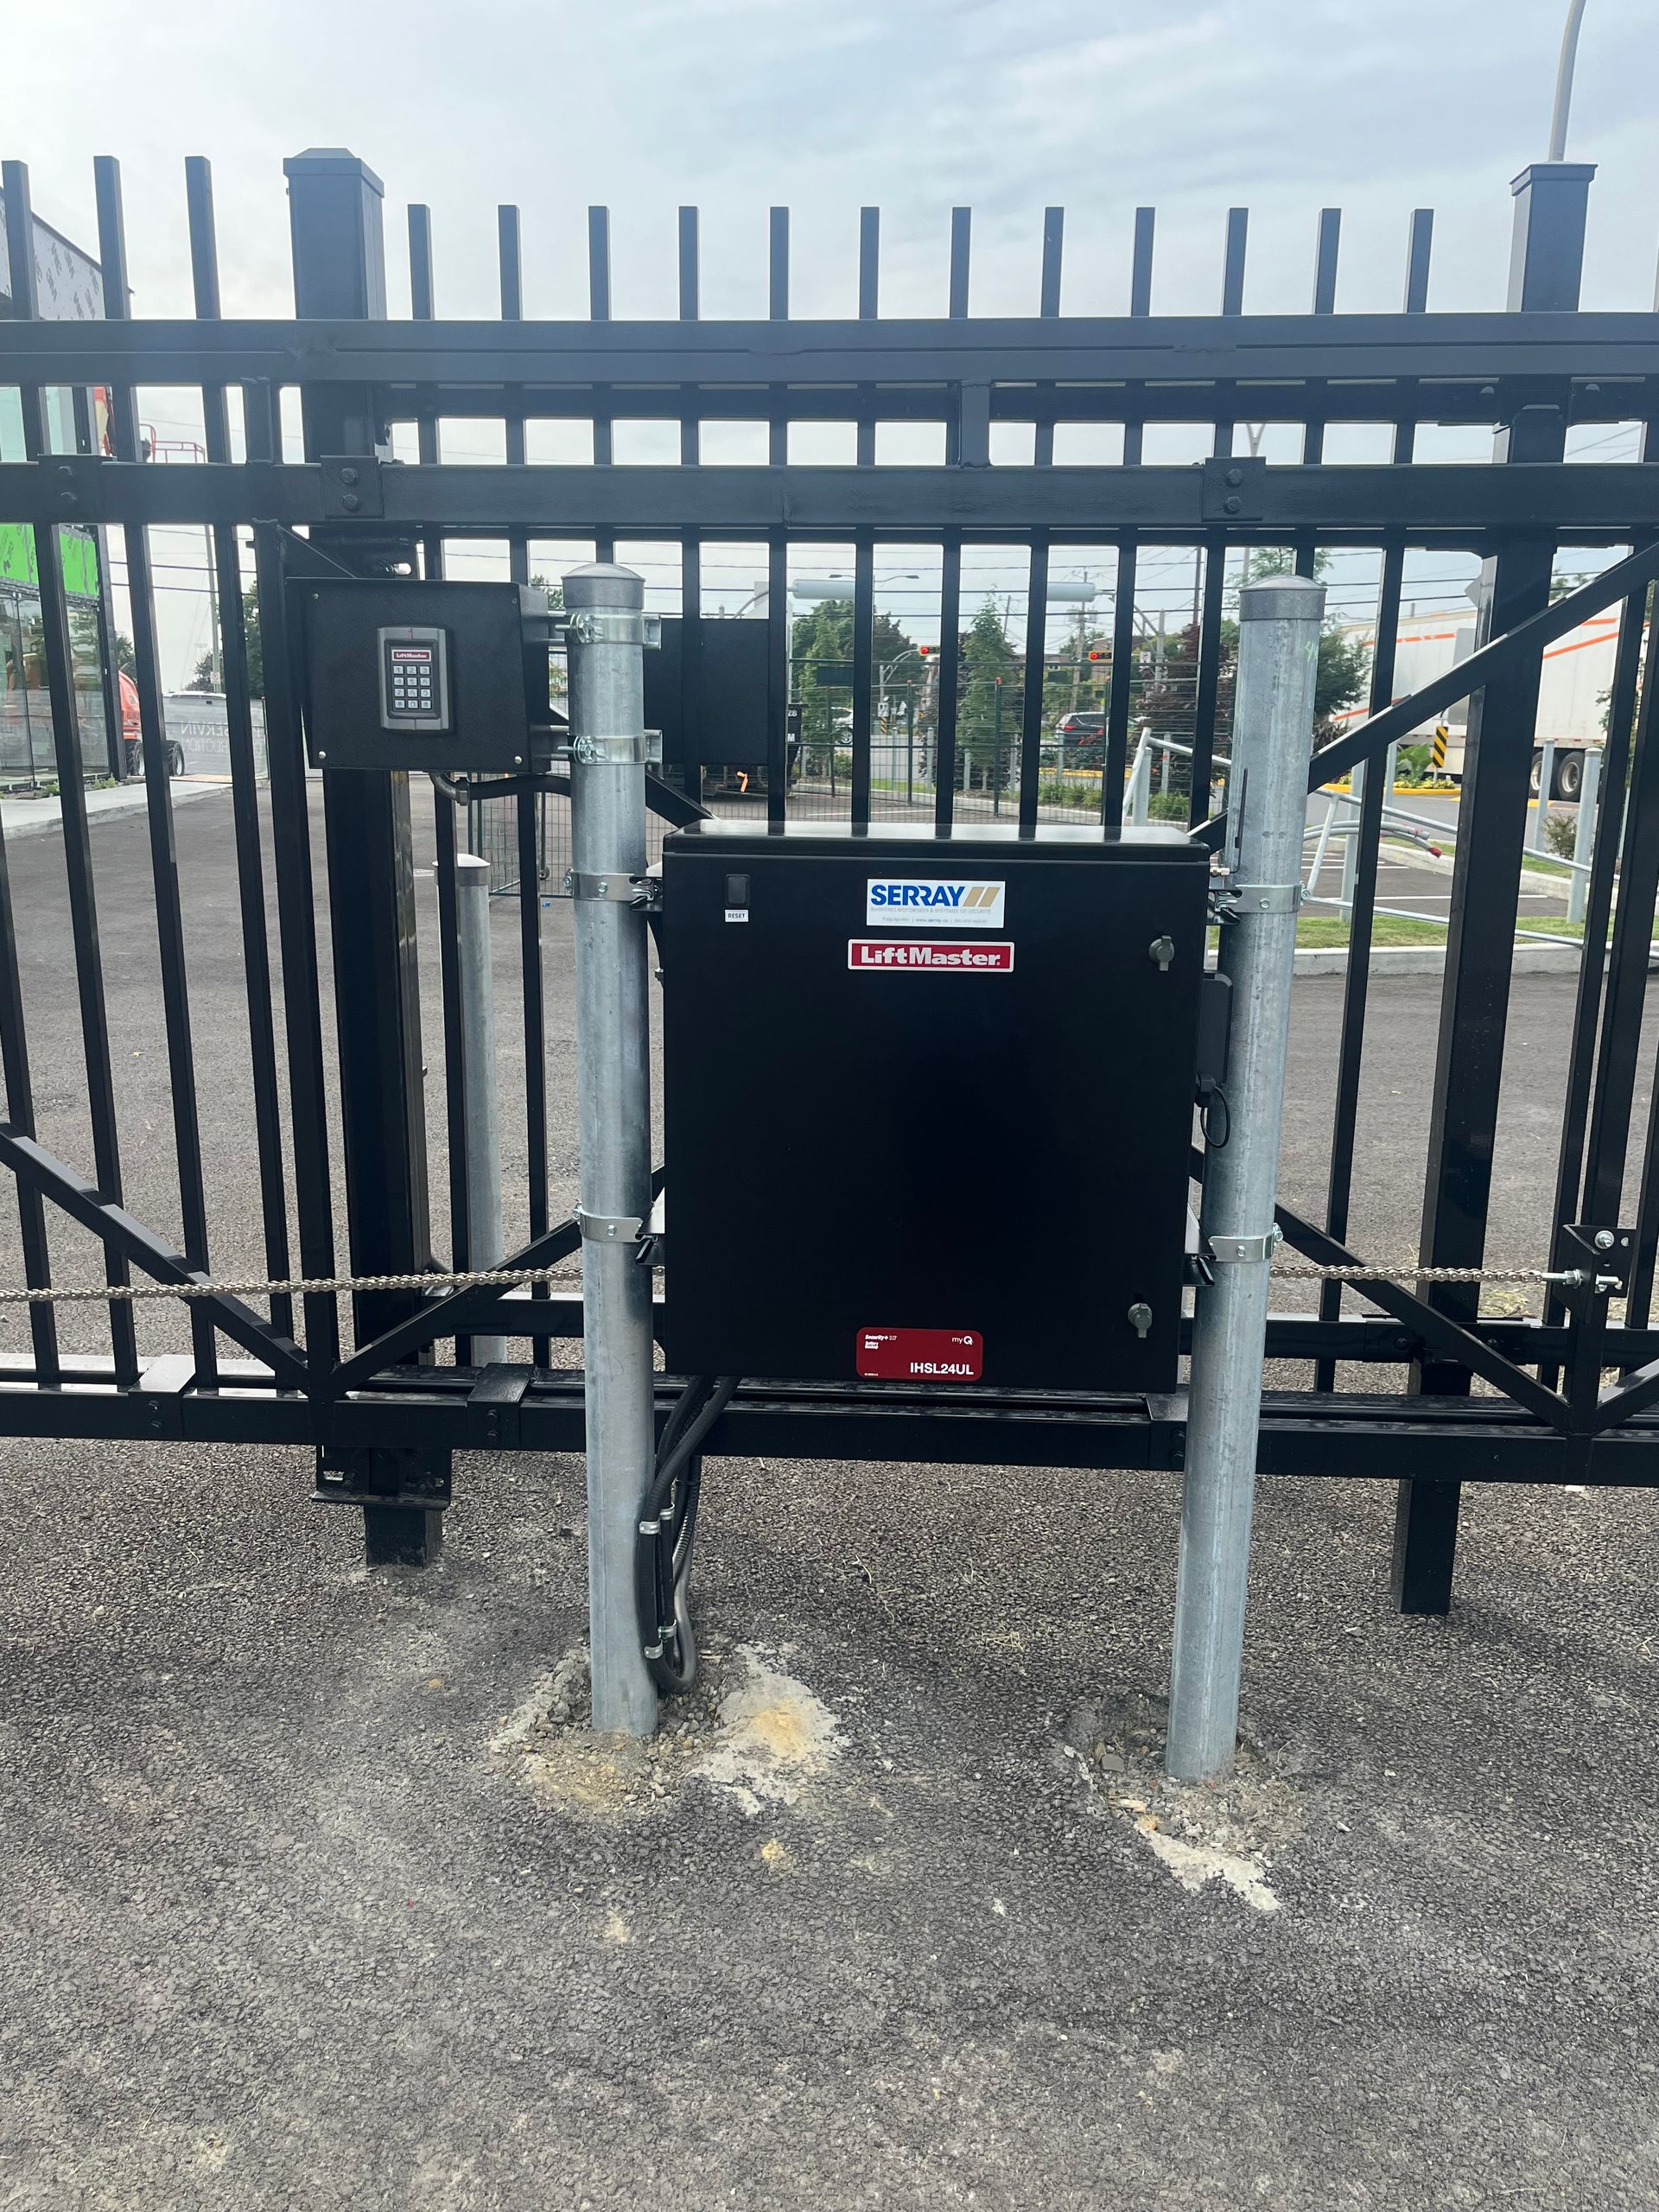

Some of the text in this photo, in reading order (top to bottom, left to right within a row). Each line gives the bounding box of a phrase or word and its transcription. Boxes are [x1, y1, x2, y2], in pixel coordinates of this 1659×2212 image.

[871, 885, 965, 906] SERRAY
[951, 1335, 974, 1345] myQ
[910, 1362, 975, 1376] IHSL24UL
